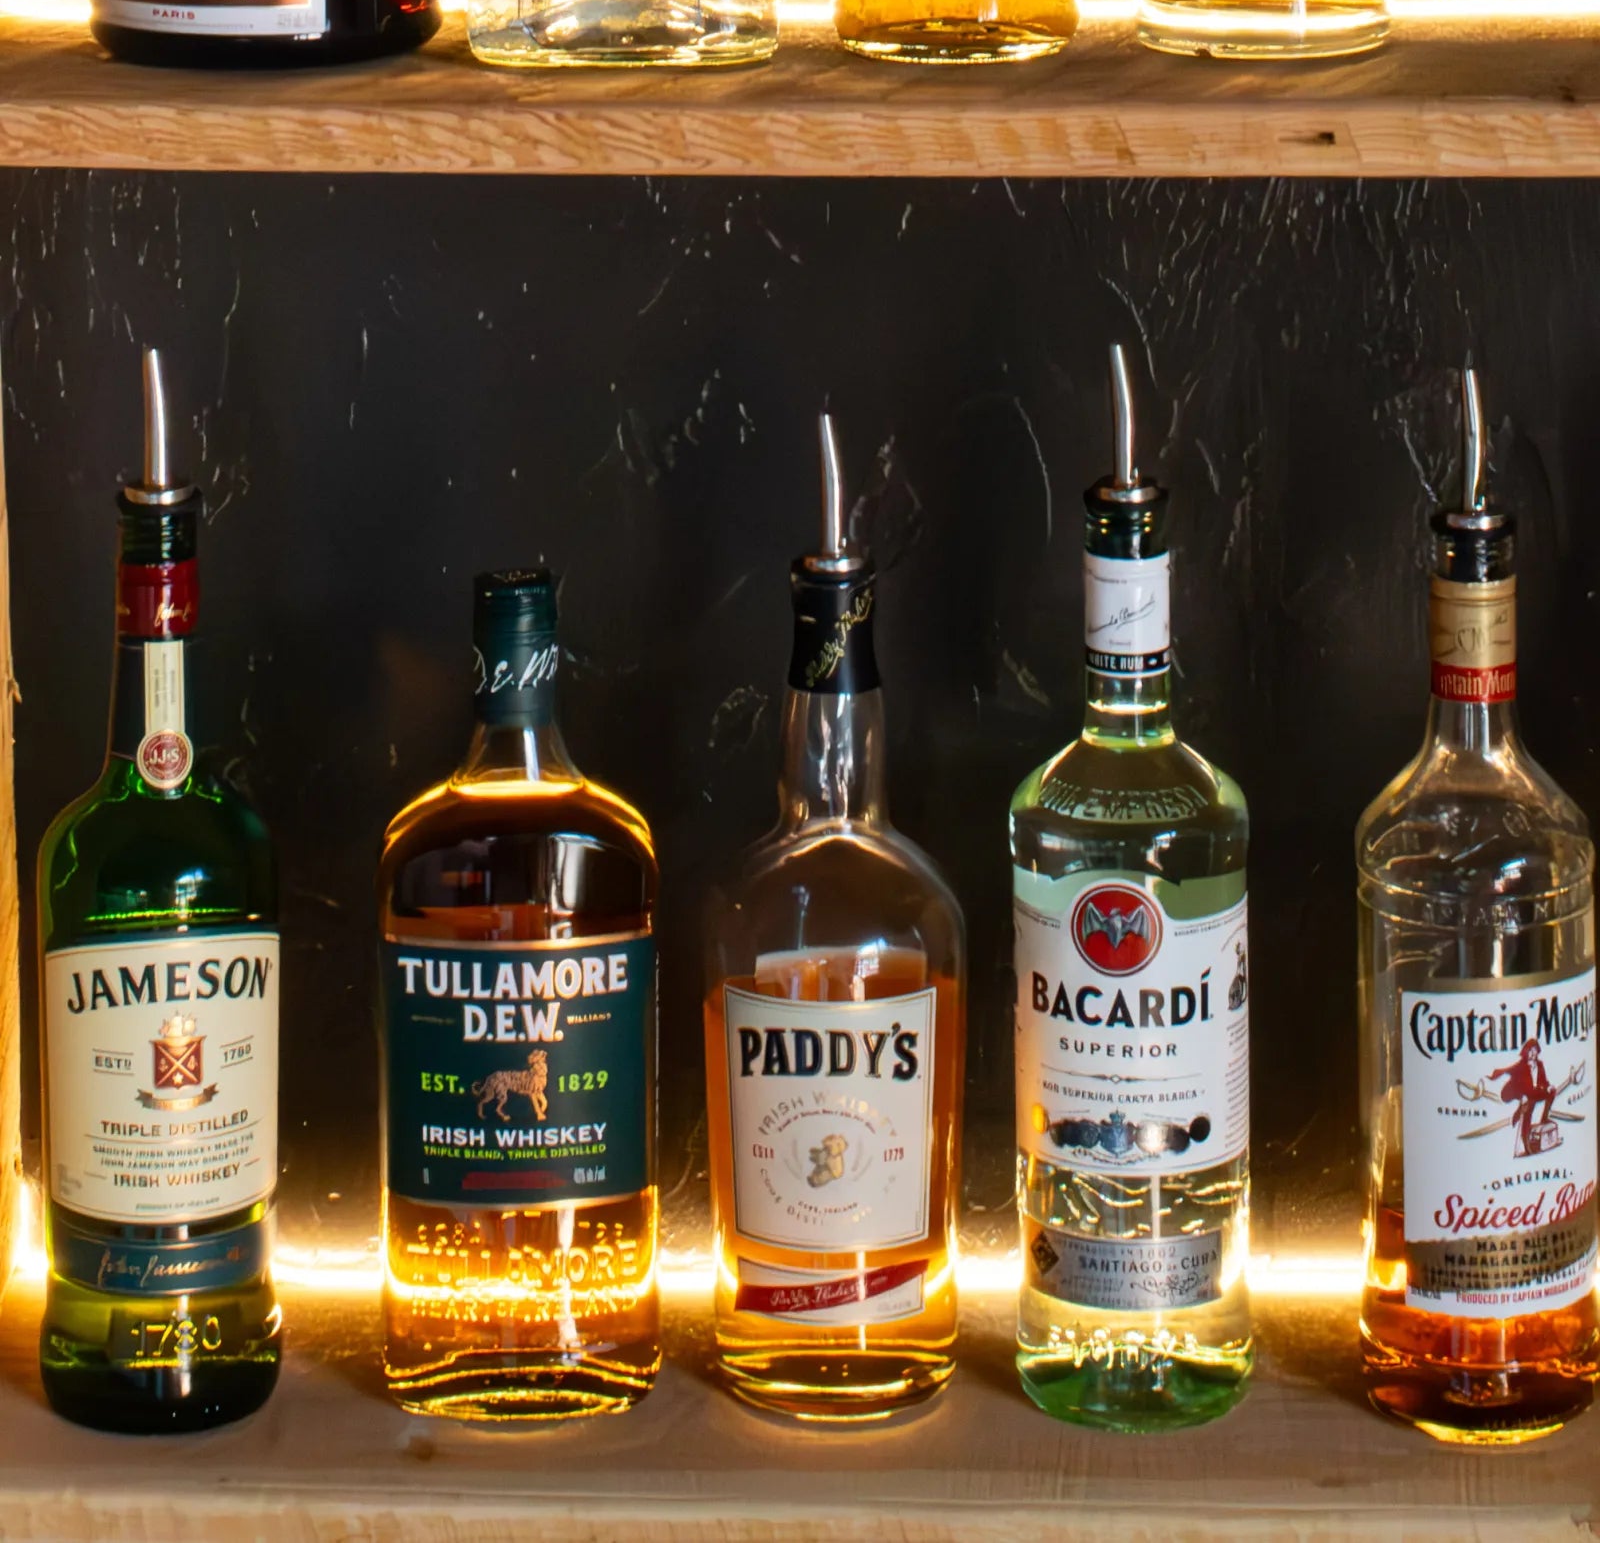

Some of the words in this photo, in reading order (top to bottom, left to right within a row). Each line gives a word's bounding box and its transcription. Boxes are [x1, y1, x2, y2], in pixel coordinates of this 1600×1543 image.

[152, 8, 196, 20] PARIS
[67, 957, 270, 1014] JAMESON
[397, 954, 629, 1000] TULLAMORE
[1032, 967, 1212, 1028] BACARDÍ
[463, 1001, 564, 1042] D.E.W.
[1410, 1001, 1527, 1062] Captain
[1529, 990, 1597, 1046] Morga
[738, 1022, 919, 1082] PADDY'S
[1059, 1036, 1178, 1058] SUPERIOR
[420, 1071, 465, 1095] EST.
[557, 1070, 610, 1093] 1829
[1062, 1085, 1114, 1104] SUPERIOR
[101, 1120, 161, 1138] TRIPLE
[168, 1108, 249, 1137] DISTILLED
[757, 1096, 804, 1136] IRISH
[1437, 1106, 1488, 1118] GENUINE
[422, 1123, 486, 1147] IRISH
[495, 1122, 608, 1148] WHISKEY
[423, 1144, 461, 1158] TRIPLE
[507, 1149, 548, 1160] TRIPLE
[550, 1143, 607, 1158] DISTILLED
[113, 1173, 160, 1188] IRISH
[166, 1161, 242, 1187] WHISKEY
[1490, 1167, 1568, 1192] ORIGINAL
[1433, 1190, 1546, 1235] Spiced
[1549, 1178, 1595, 1224] Rum
[1078, 1254, 1163, 1274] SANTIAGO
[1180, 1249, 1219, 1271] CUBA
[1512, 1286, 1543, 1303] CAPTAIN
[130, 1315, 222, 1356] 1780
